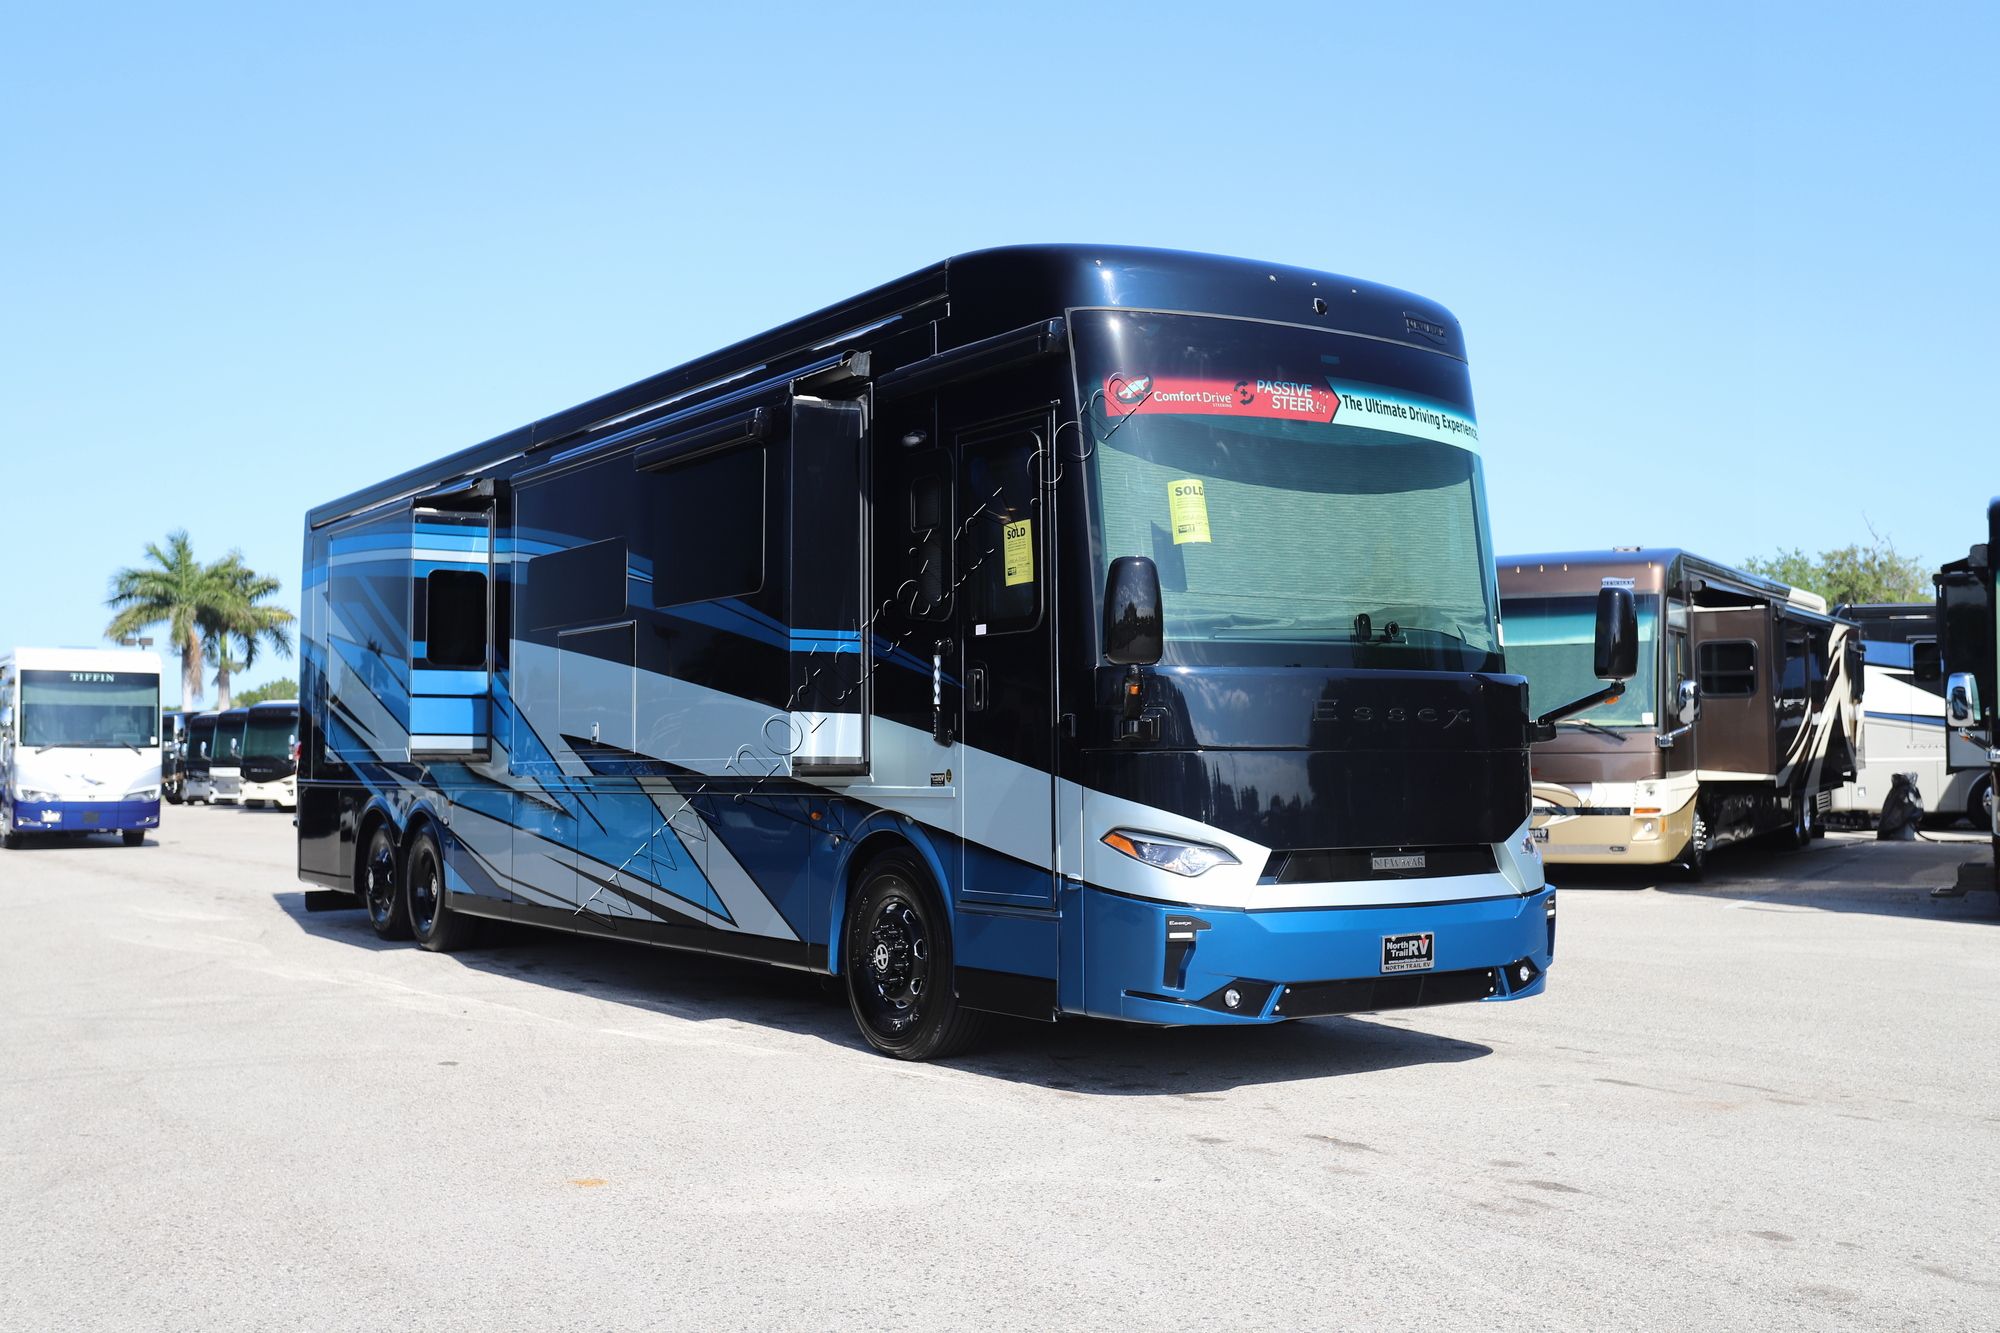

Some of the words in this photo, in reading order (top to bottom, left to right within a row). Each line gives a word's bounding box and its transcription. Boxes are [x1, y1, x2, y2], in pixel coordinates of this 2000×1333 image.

[1256, 379, 1312, 398] PASSIVE
[1154, 390, 1201, 403] Comfort
[1272, 396, 1315, 413] STEER
[1342, 394, 1363, 411] The
[1365, 397, 1407, 419] Ultimate
[1409, 406, 1441, 430] Driving
[1175, 485, 1203, 496] SOLD
[1007, 527, 1026, 540] SOLD
[71, 672, 114, 682] TIFFIN
[1386, 941, 1408, 950] North
[1409, 938, 1430, 956] RV
[1391, 949, 1408, 957] Trail
[1406, 961, 1421, 969] TRAIL
